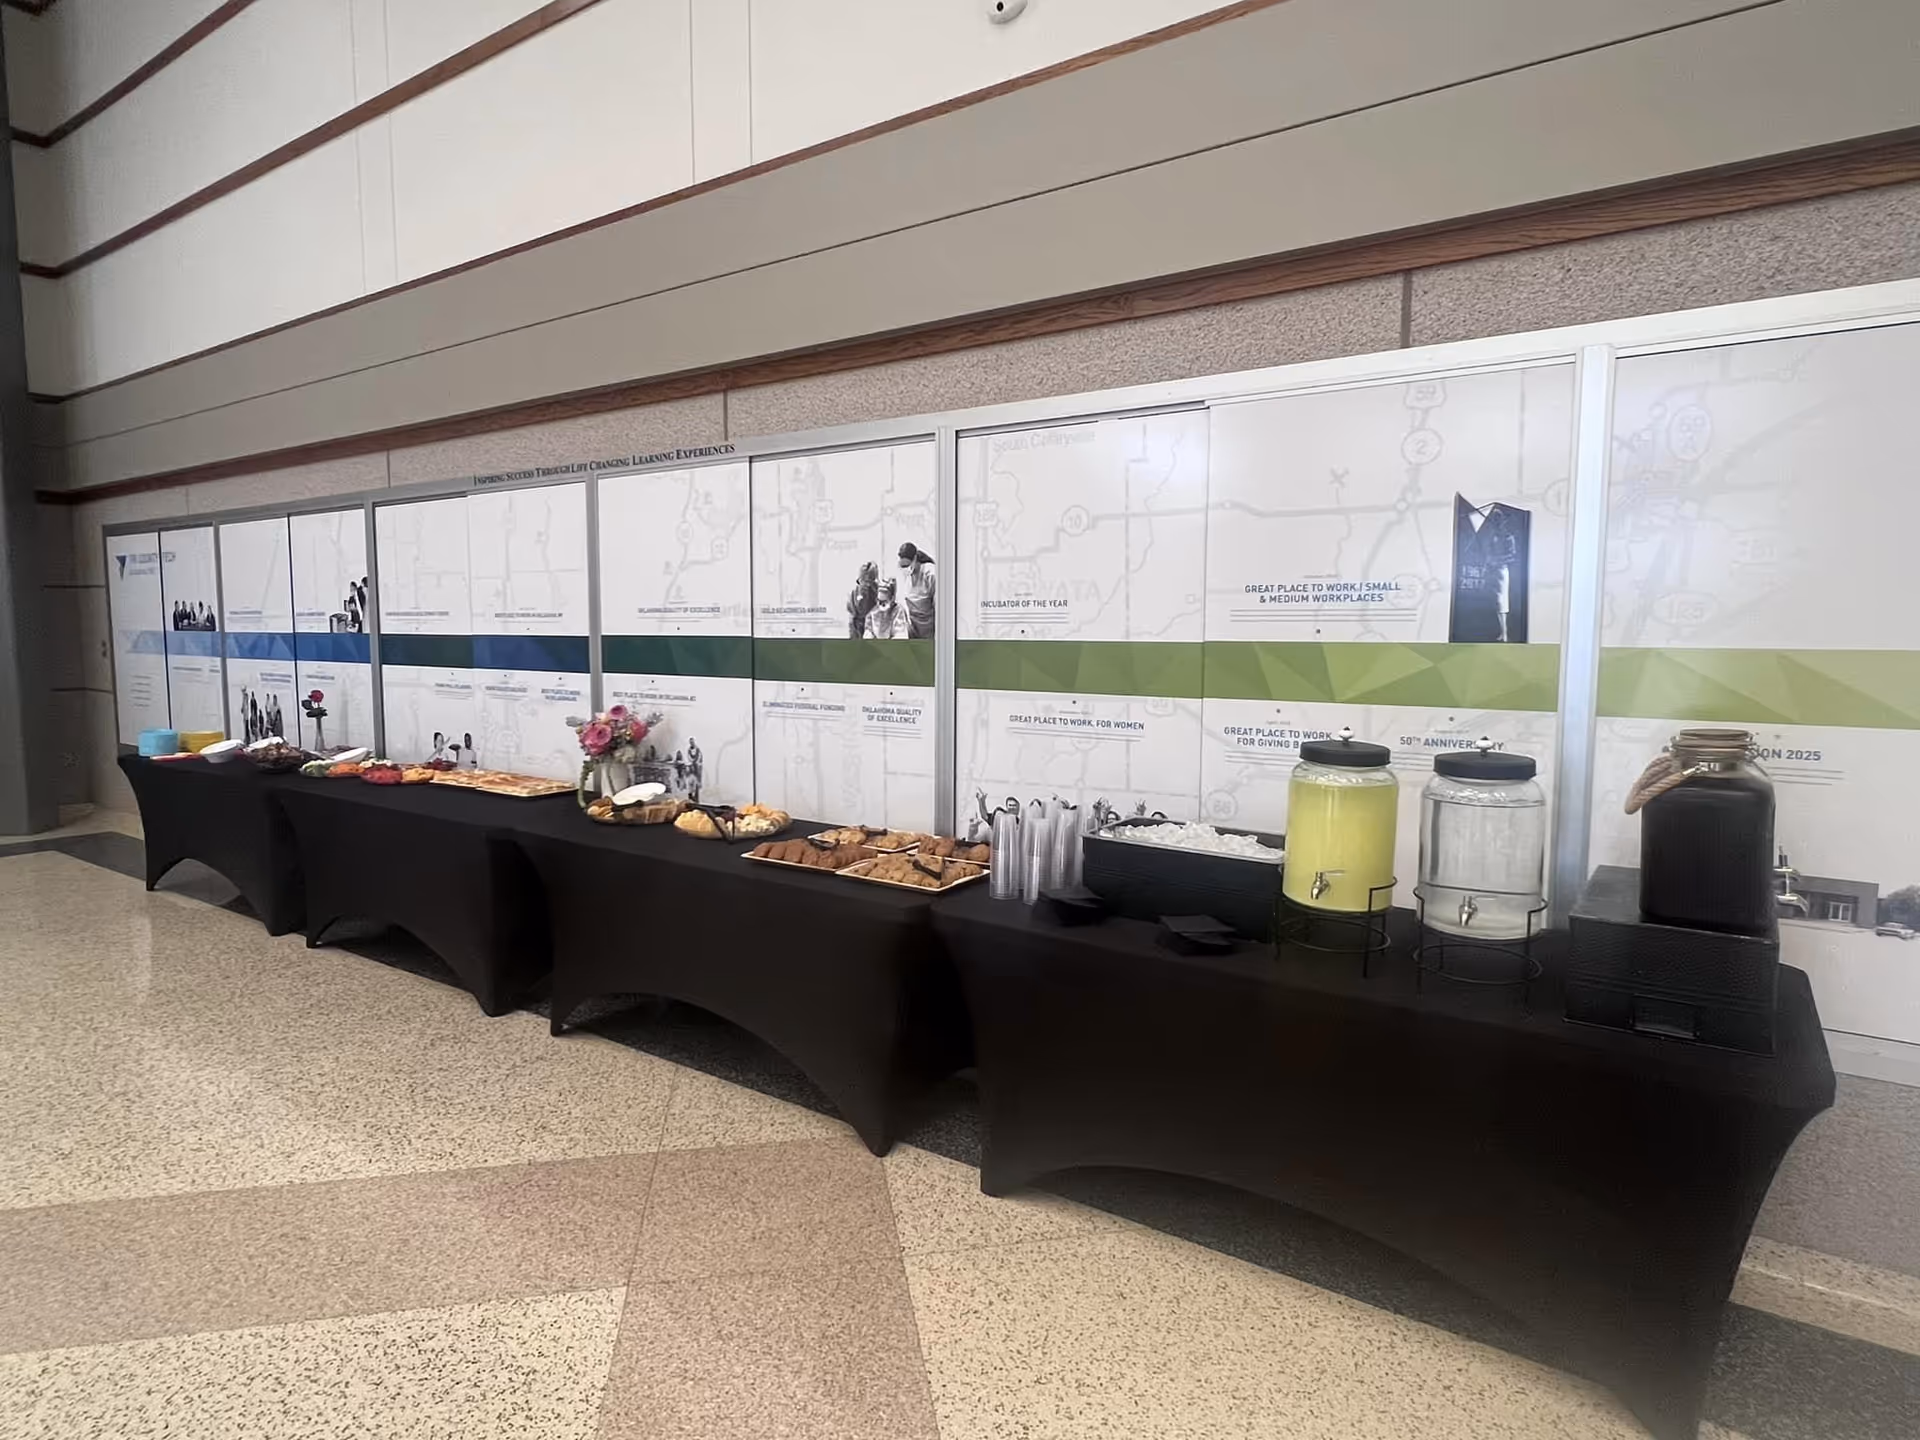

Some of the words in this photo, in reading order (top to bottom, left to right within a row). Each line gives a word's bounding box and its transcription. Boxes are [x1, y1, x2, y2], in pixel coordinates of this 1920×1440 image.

[506, 470, 534, 482] SUCCESS
[535, 466, 570, 478] THROUGH
[571, 462, 588, 474] LIFE
[589, 457, 630, 471] CHANGING
[632, 451, 675, 466] LEARNING
[676, 443, 736, 460] EXPERIENCES
[1244, 584, 1275, 594] GREAT
[1277, 583, 1309, 593] PLACE
[1311, 583, 1324, 593] TO
[1365, 582, 1401, 592] SMALL
[980, 599, 1021, 608] INCUBATOR
[1021, 599, 1031, 608] OF
[1032, 599, 1047, 608] THE
[1048, 599, 1068, 608] YEAR
[1259, 595, 1267, 604] &
[1269, 594, 1309, 604] MEDIUM
[1312, 593, 1384, 603] WORKPLACES
[862, 705, 895, 715] OKLAHOMA
[895, 707, 922, 716] QUALITY
[876, 715, 917, 725] EXCELLENCE
[1009, 714, 1032, 724] GREAT
[1033, 716, 1057, 725] PLACE
[1058, 717, 1069, 726] TO
[1096, 719, 1112, 729] FOR
[1112, 720, 1145, 731] WOMEN
[1223, 726, 1253, 736] GREAT
[1255, 728, 1286, 738] PLACE
[1288, 729, 1300, 739] TO
[1236, 737, 1256, 747] FOR
[1257, 738, 1291, 749] GIVING
[1423, 737, 1505, 751] ANNIVERRY
[1785, 749, 1822, 761] 2025
